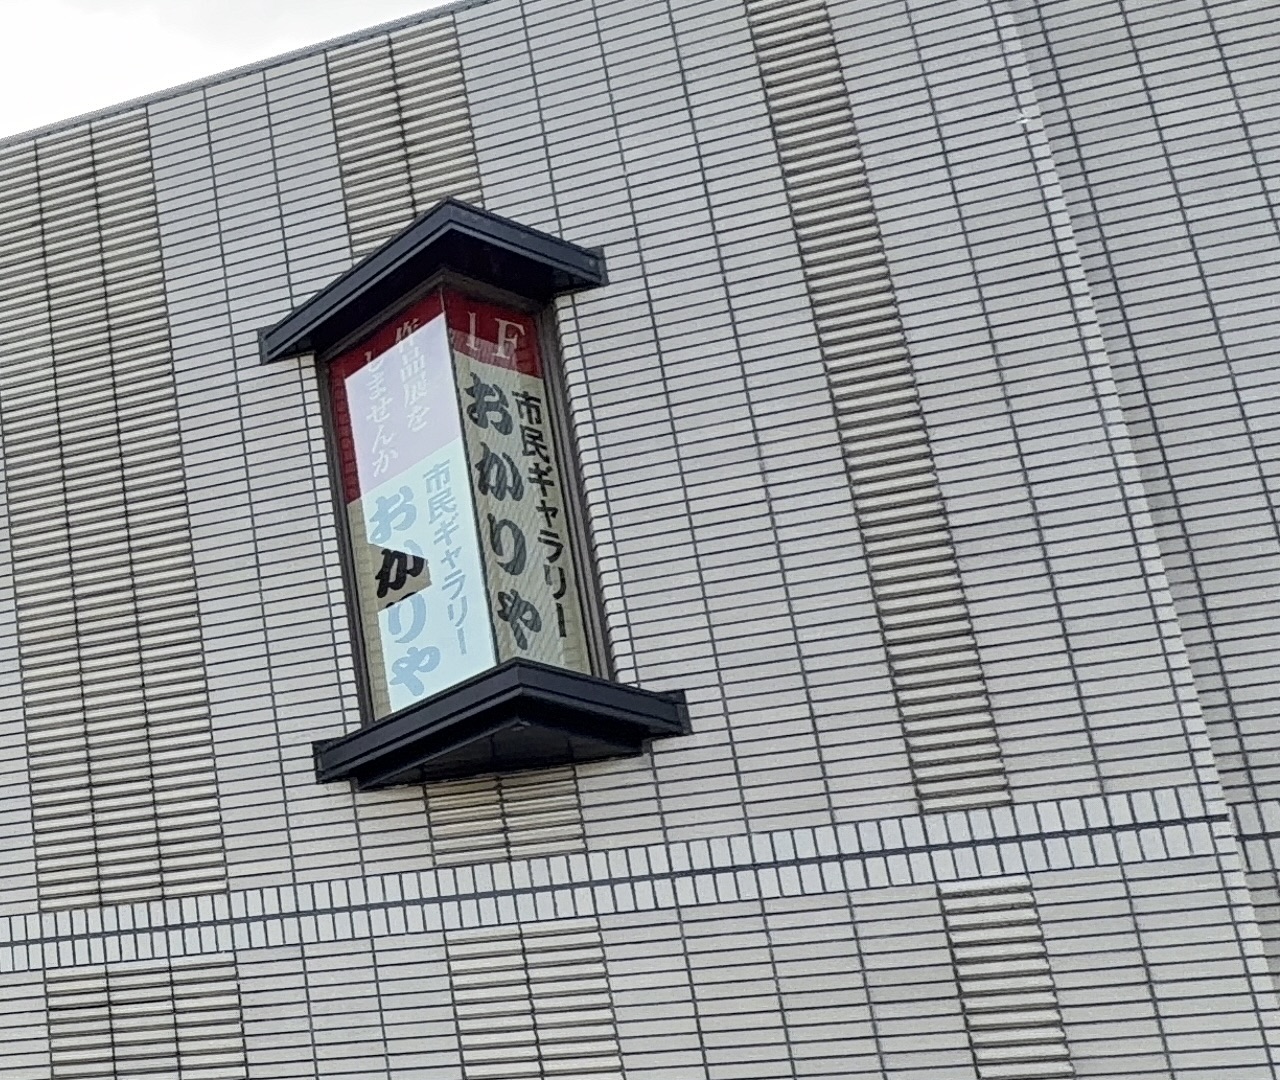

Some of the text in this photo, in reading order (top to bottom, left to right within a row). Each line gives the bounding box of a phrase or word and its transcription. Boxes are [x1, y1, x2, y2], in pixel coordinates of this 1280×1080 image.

[364, 350, 399, 477] しませんか
[394, 318, 429, 430] 作品展を
[369, 485, 441, 698] おかりや
[423, 457, 468, 655] 市民ギャラリー
[466, 371, 541, 651] おかりや
[512, 389, 567, 638] 市民ギャラリー
